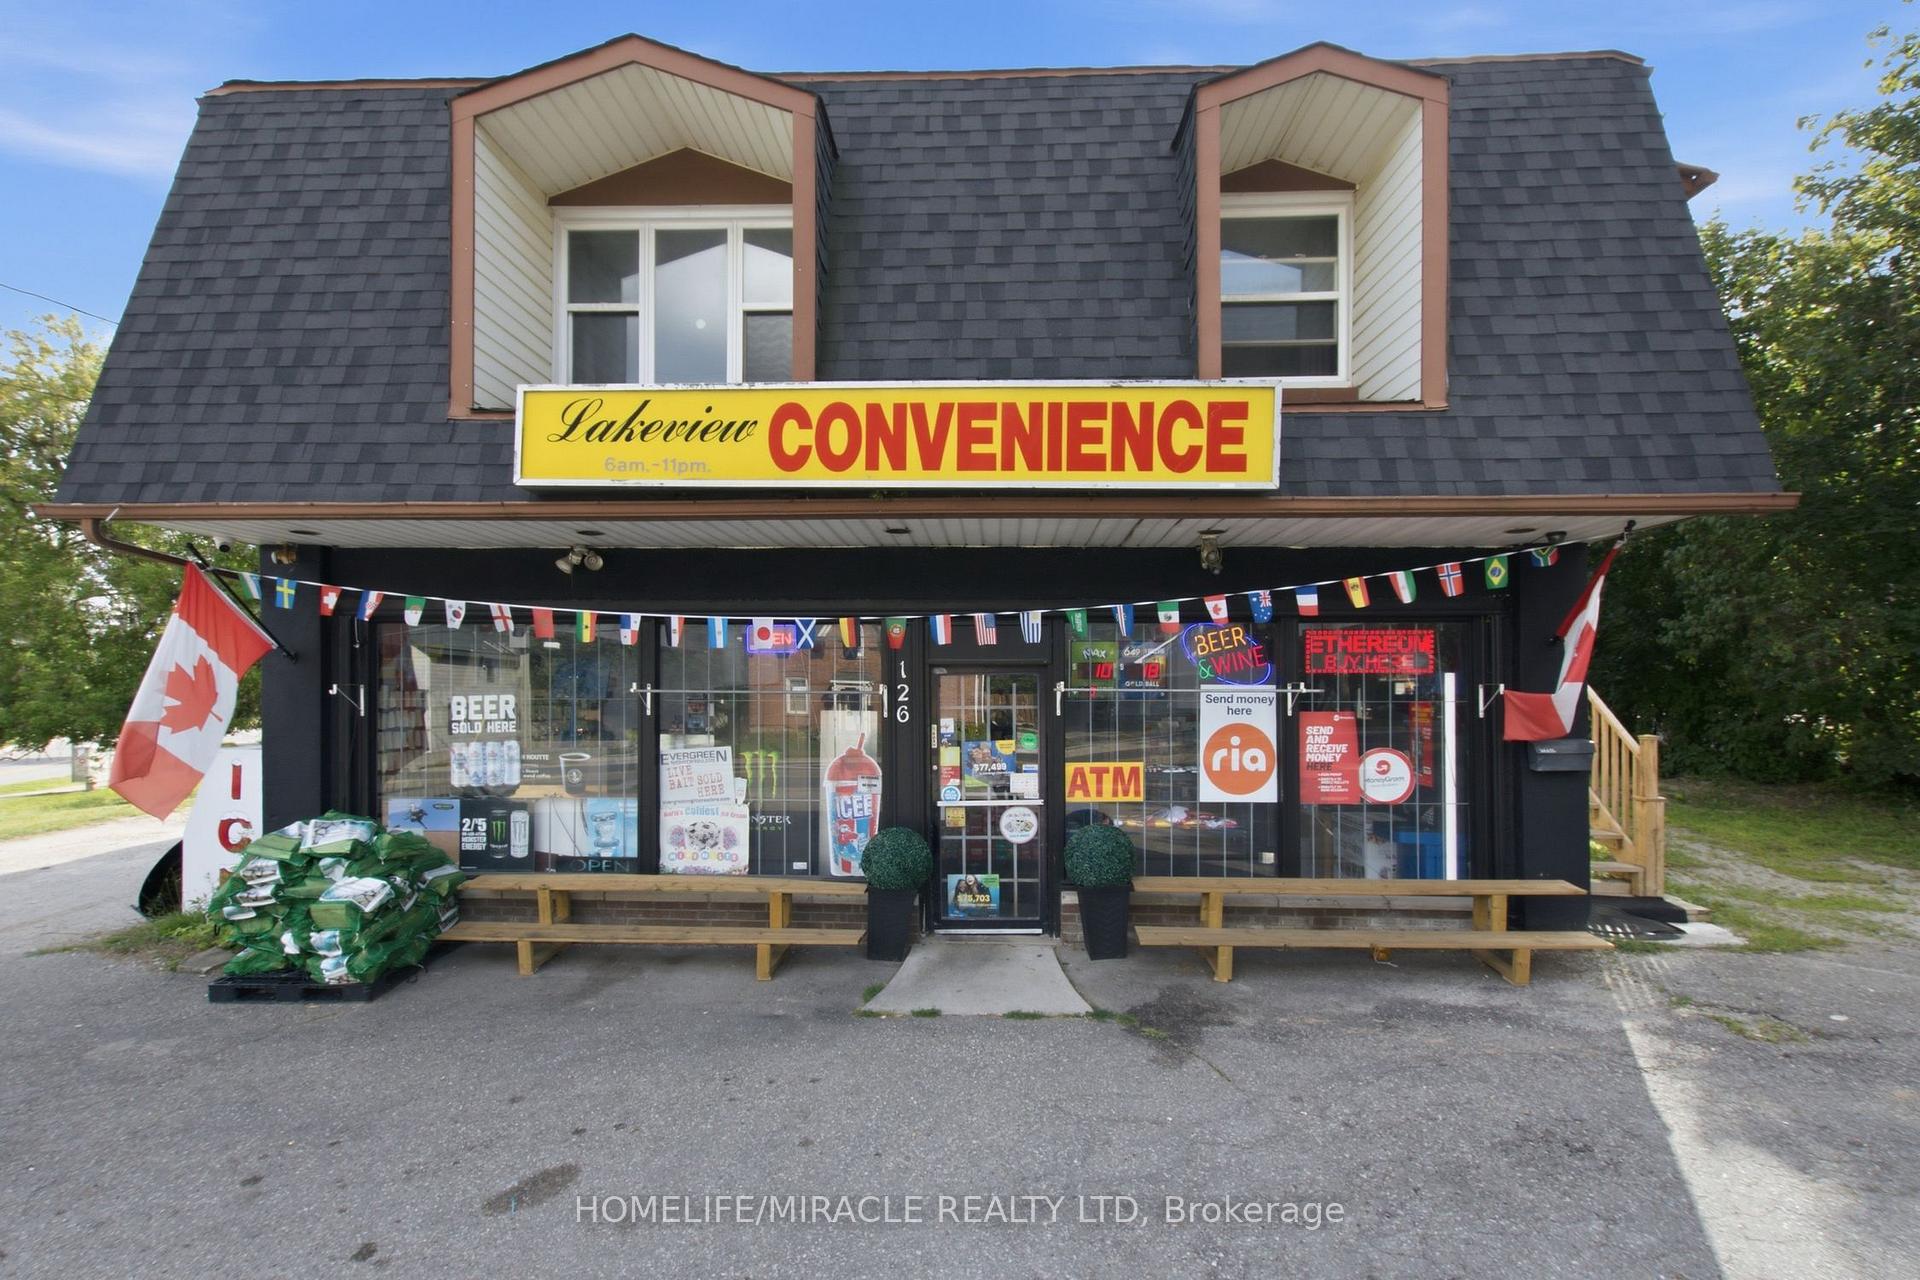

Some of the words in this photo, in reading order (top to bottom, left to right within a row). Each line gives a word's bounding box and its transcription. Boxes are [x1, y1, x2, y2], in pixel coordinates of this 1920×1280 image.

[547, 398, 758, 444] Lakeview
[767, 399, 1249, 473] CONVENIENCE
[1194, 626, 1247, 656] BEER
[1311, 635, 1431, 653] ETHEREUM
[1198, 658, 1215, 679] &
[1210, 645, 1268, 675] WINE
[1365, 655, 1414, 669] HERE
[896, 660, 910, 723] 126
[451, 694, 516, 721] BEER
[1205, 694, 1234, 704] Send
[1236, 695, 1275, 706] money
[1227, 706, 1253, 716] here
[451, 721, 482, 734] SOLD
[487, 720, 517, 733] HERE
[1305, 726, 1334, 735] SEND
[1305, 735, 1329, 744] AND
[1211, 736, 1267, 772] ria
[1305, 744, 1349, 753] RECEIVE
[660, 749, 728, 765] EVERGREEN
[1305, 753, 1342, 762] MONEY
[667, 765, 693, 778] LIVE
[1306, 762, 1333, 771] HERE
[668, 776, 694, 790] BAIT
[697, 772, 723, 785] SOLD
[1066, 766, 1142, 798] ATM
[697, 783, 725, 798] HERE
[836, 795, 873, 819] ICEE
[751, 815, 792, 825] NSTER
